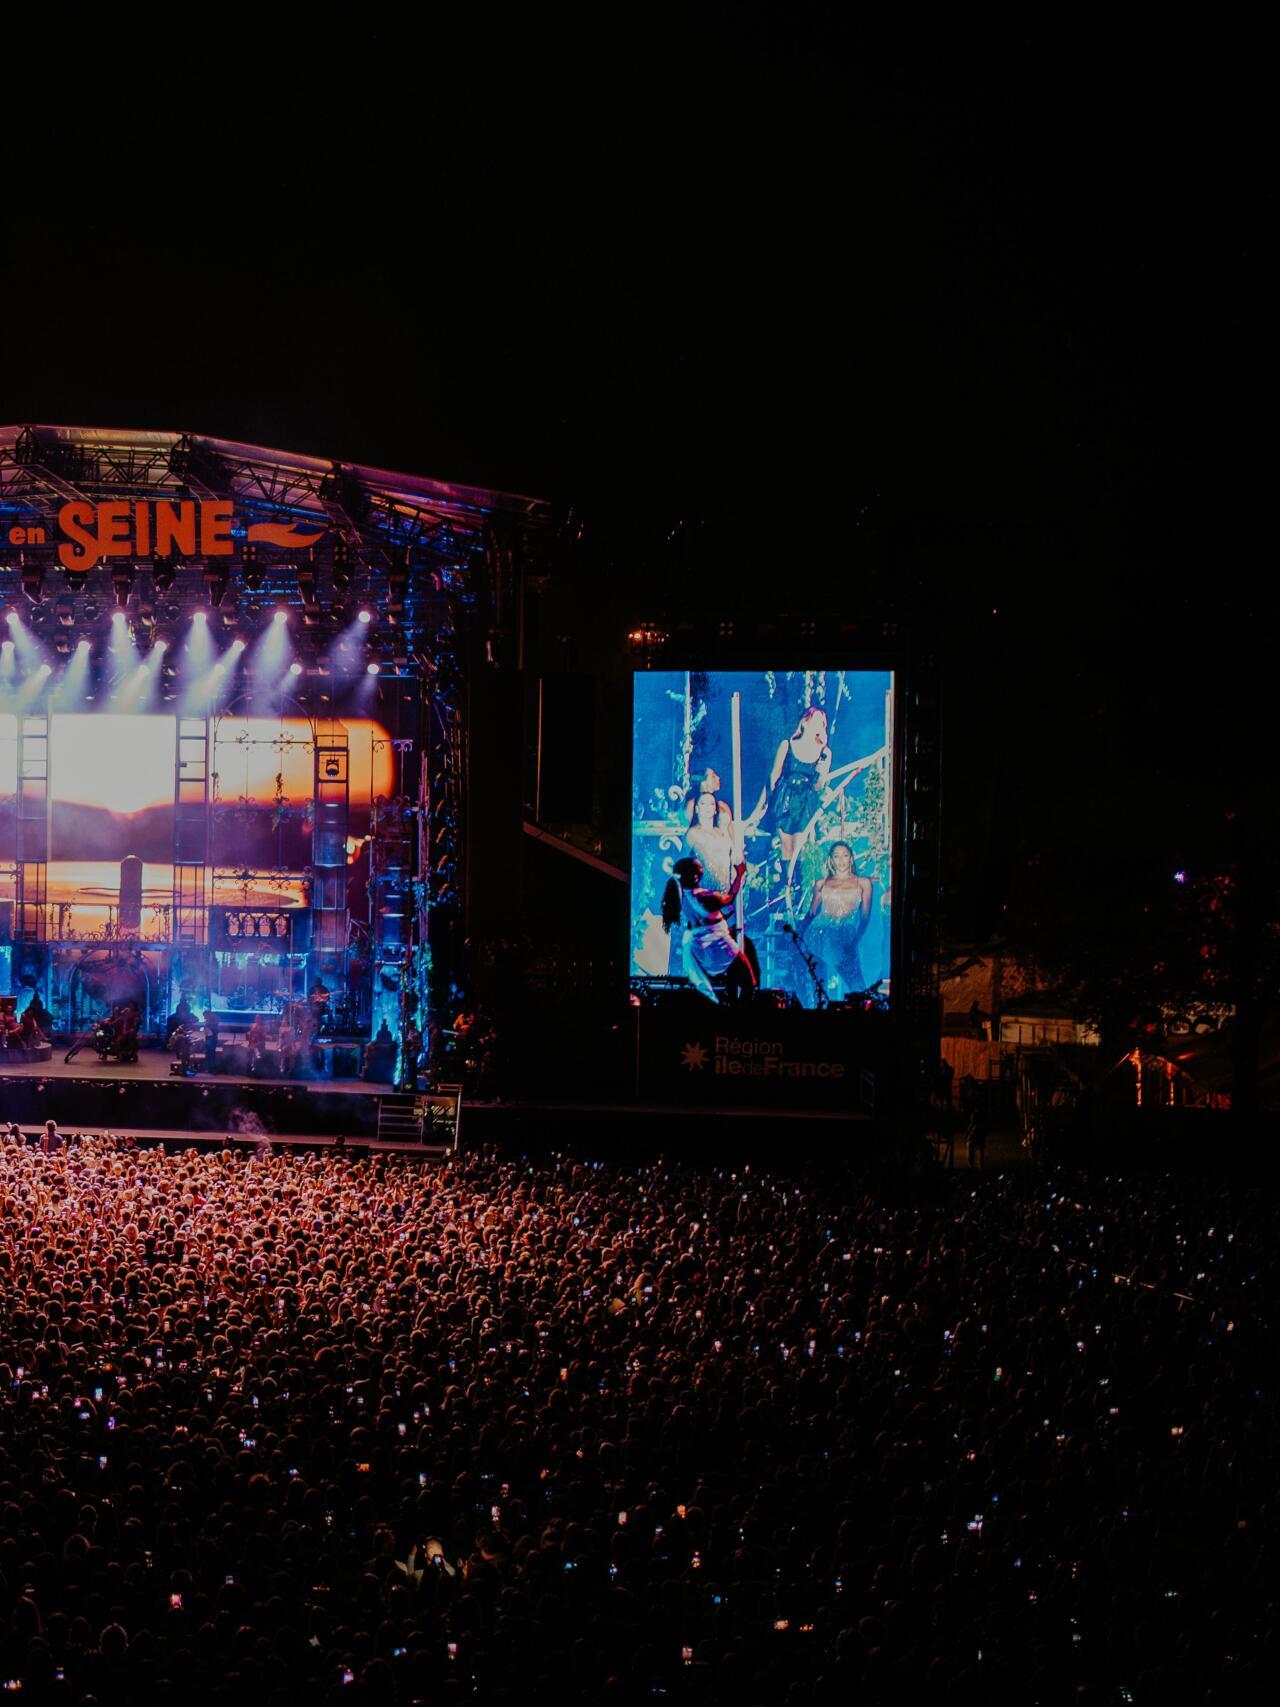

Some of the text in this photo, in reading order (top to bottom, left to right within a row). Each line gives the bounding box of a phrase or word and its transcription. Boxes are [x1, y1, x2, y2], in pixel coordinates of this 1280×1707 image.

[8, 525, 46, 545] en
[57, 499, 235, 572] SEINE
[714, 1036, 784, 1058] Région
